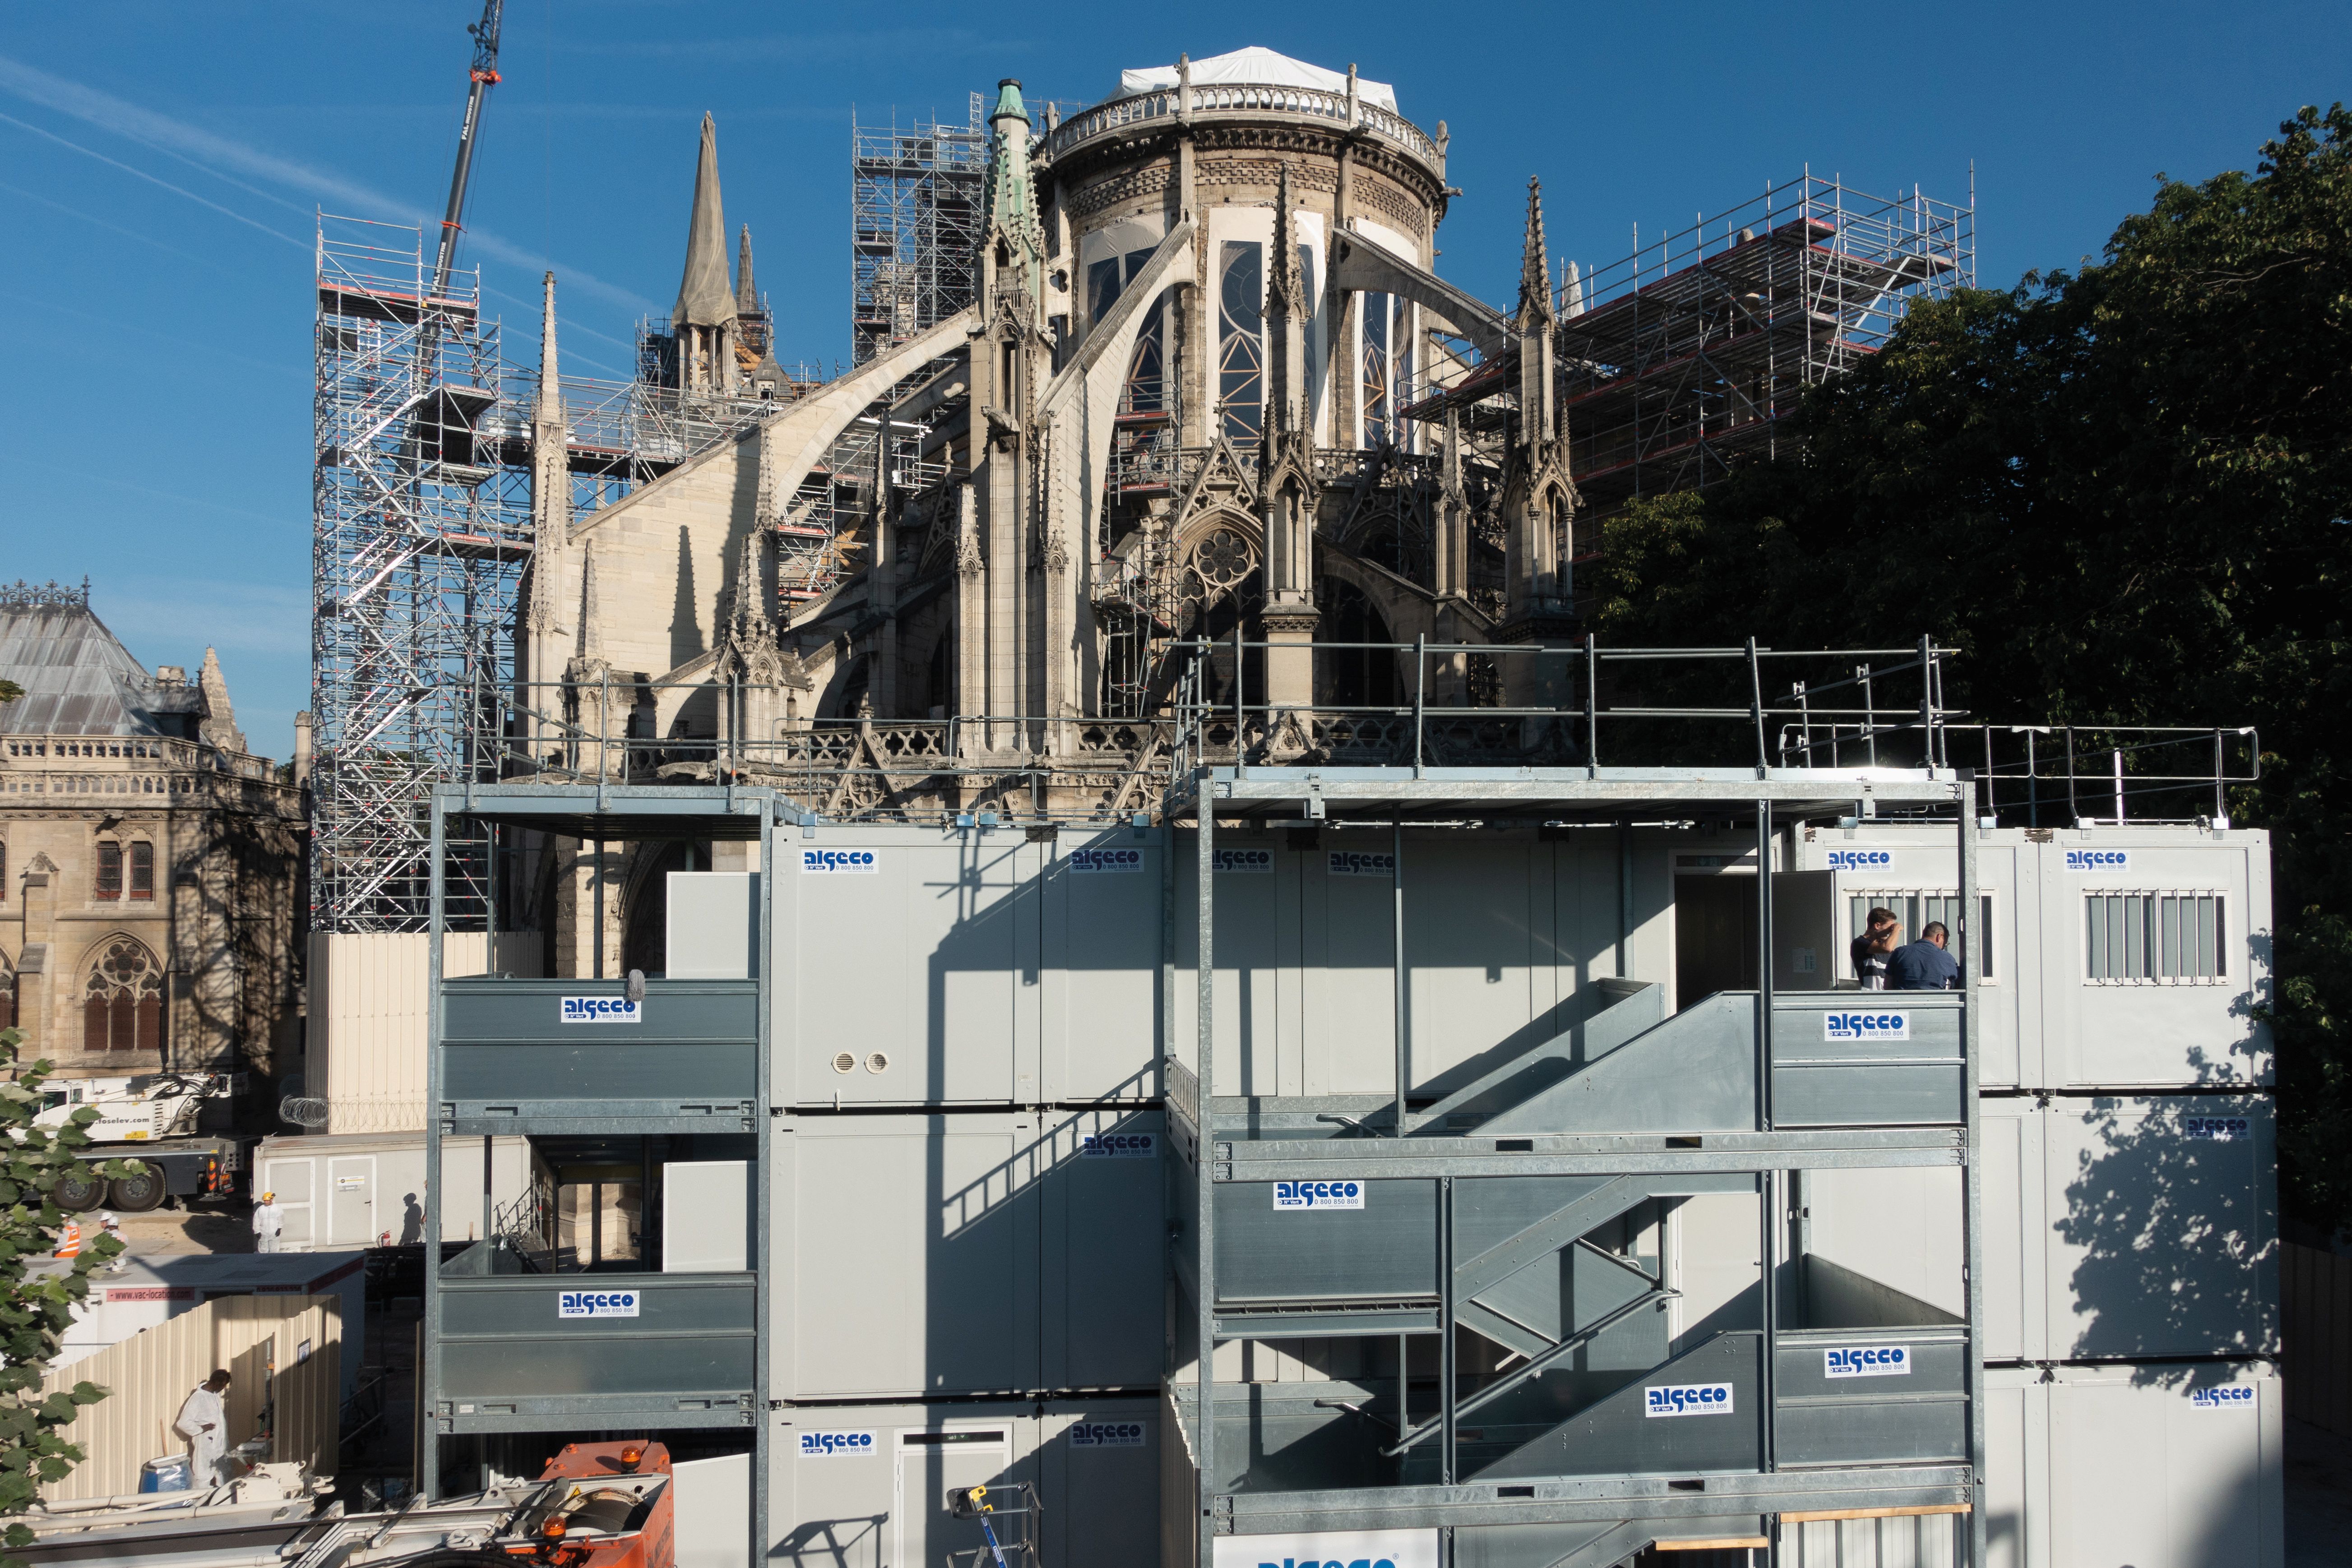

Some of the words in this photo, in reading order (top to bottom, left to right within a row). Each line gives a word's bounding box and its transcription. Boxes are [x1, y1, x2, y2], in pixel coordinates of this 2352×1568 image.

[465, 96, 474, 124] INDUSTRIE
[432, 274, 440, 291] FAL
[805, 851, 873, 871] algeco
[1073, 850, 1139, 870] algeco
[1212, 850, 1269, 870] lgeco
[1331, 852, 1393, 874] algeco
[1829, 851, 1889, 870] algeco
[2067, 851, 2125, 870] algeco
[565, 999, 635, 1020] algeco
[1829, 1014, 1903, 1038] algeco
[1085, 1135, 1151, 1156] algeco
[1278, 1182, 1358, 1207] algeco
[116, 1289, 190, 1299] www.vac-location.com
[563, 1293, 634, 1314] algeco
[1829, 1349, 1904, 1373] algeco
[1650, 1388, 1727, 1413] algeco
[2193, 1388, 2251, 1406] algeco
[802, 1433, 871, 1454] algeco
[1074, 1424, 1140, 1445] algeco
